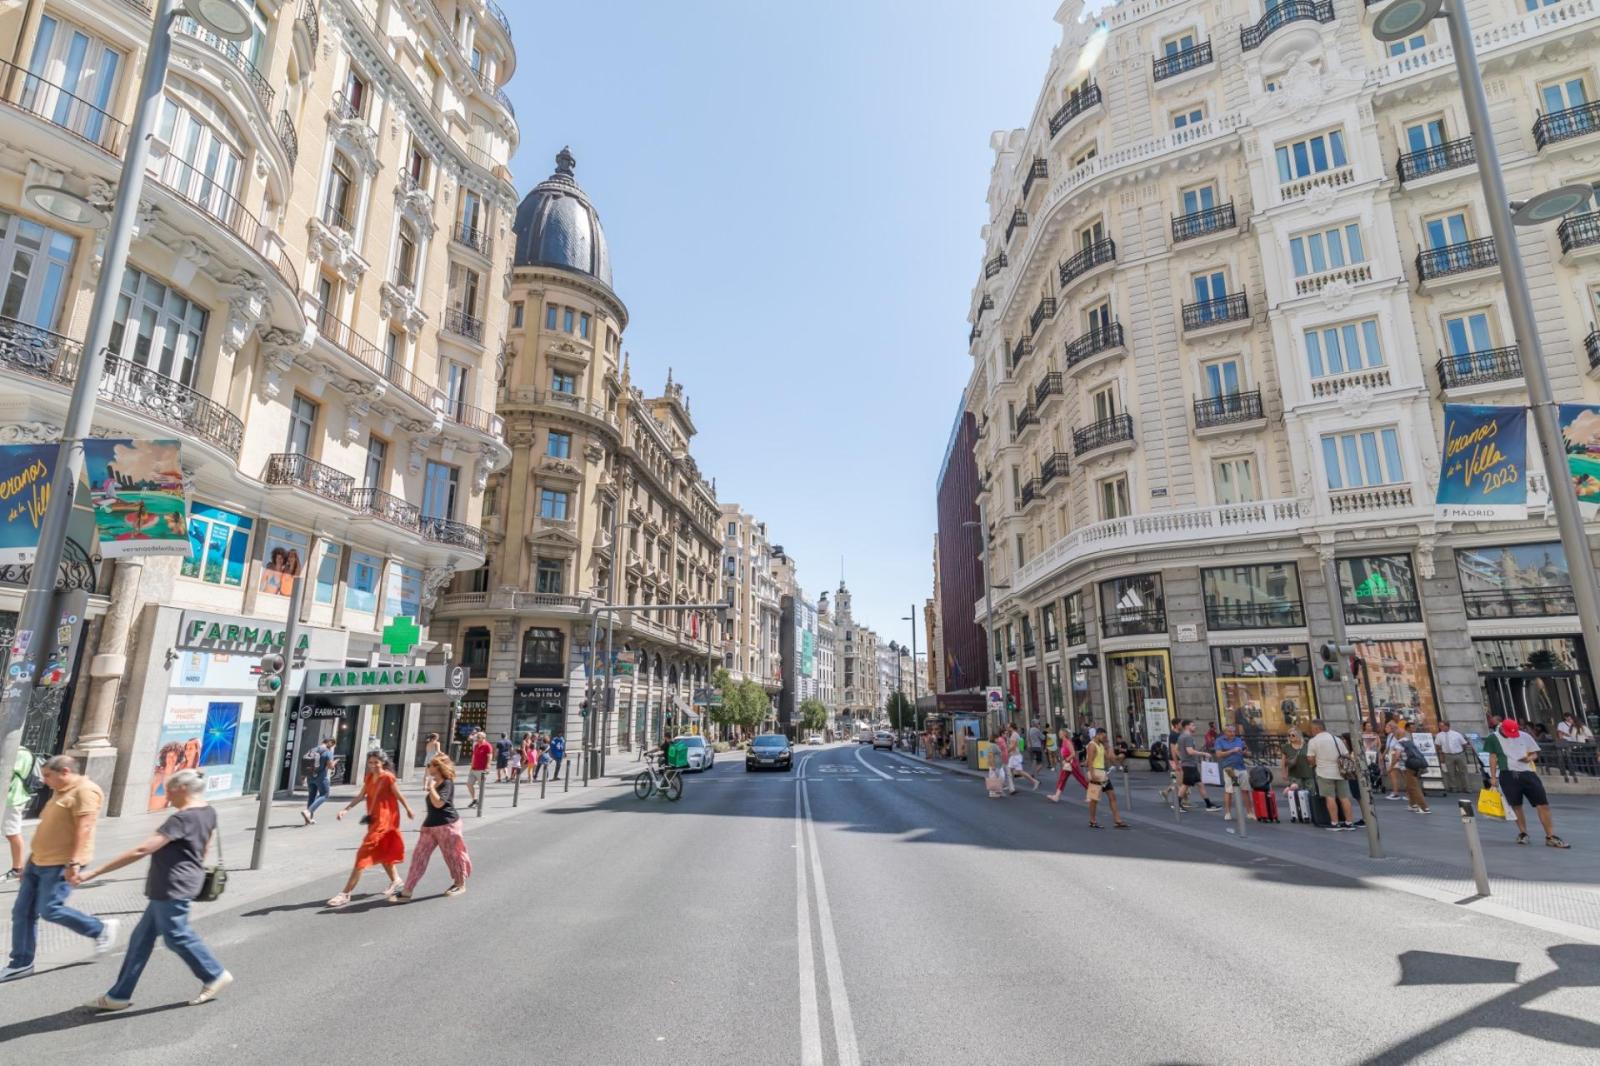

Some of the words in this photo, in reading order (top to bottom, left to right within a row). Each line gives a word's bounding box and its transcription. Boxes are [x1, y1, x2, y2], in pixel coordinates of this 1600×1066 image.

[1446, 419, 1498, 461] Veranos
[0, 458, 48, 499] eranos
[1465, 442, 1507, 488] Villa
[1482, 463, 1519, 495] 2023
[27, 481, 52, 529] Vill
[192, 620, 310, 649] FARMACA
[318, 669, 428, 687] FARMACIA
[314, 707, 347, 717] FARMACIA
[462, 701, 487, 709] ASINO
